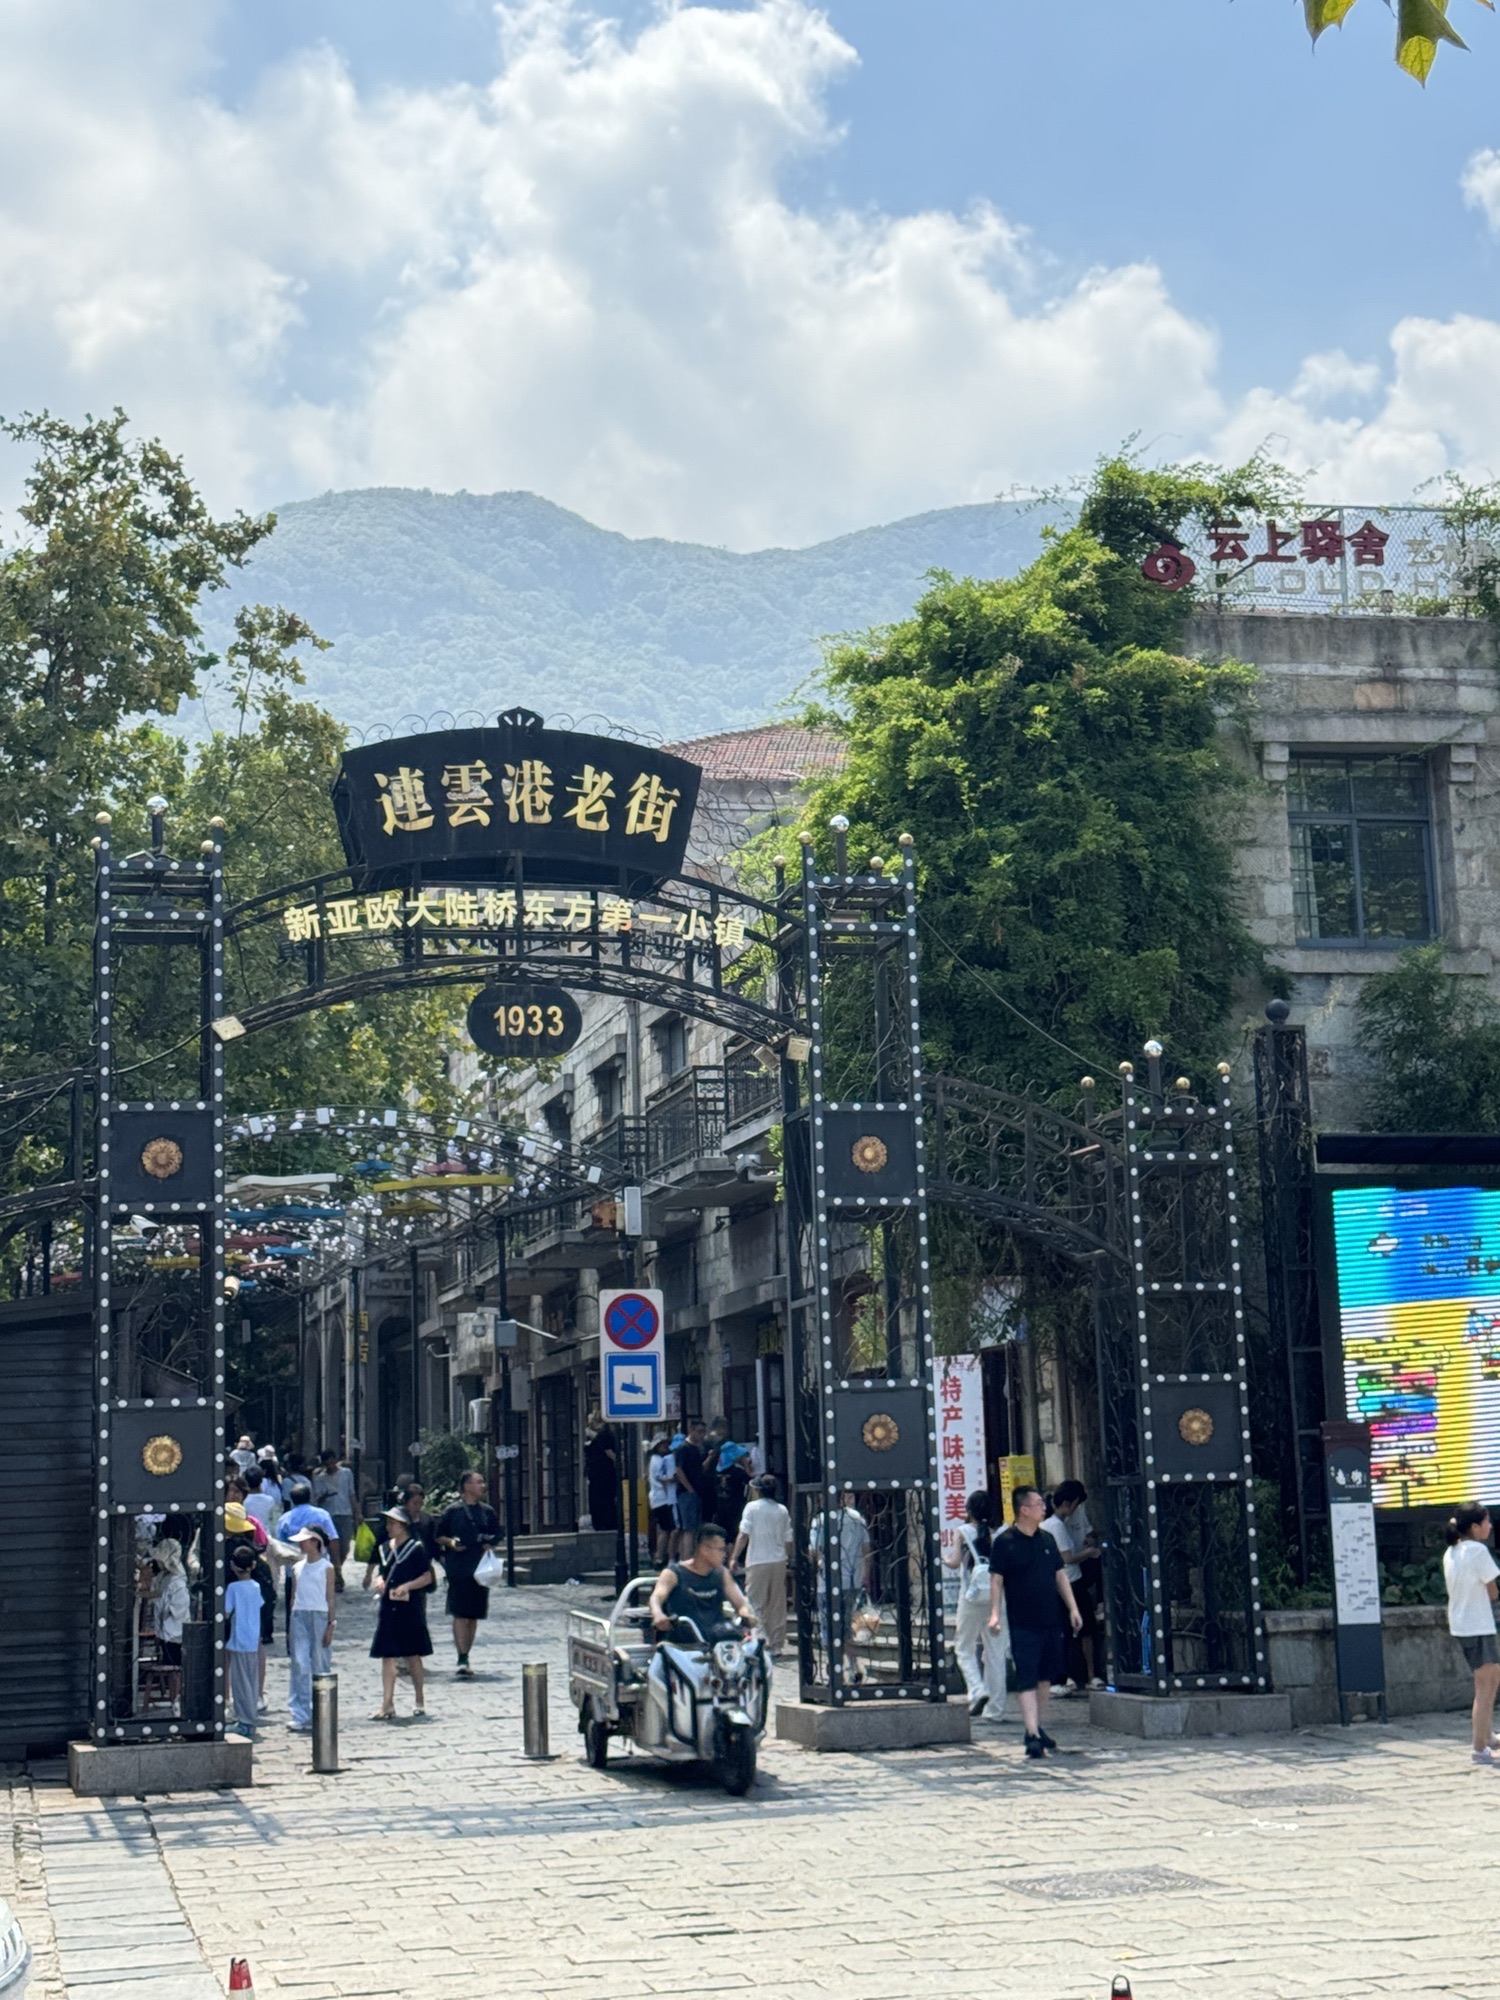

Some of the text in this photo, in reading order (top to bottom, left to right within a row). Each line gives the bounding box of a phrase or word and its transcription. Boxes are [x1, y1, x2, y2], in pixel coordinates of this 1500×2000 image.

[1206, 519, 1389, 567] 云上驿舍
[374, 760, 681, 843] 連雲港老街
[284, 890, 746, 950] 新亚欧大陆桥东方第一小镇
[493, 1005, 564, 1037] 1933
[369, 1278, 423, 1291] HOTE
